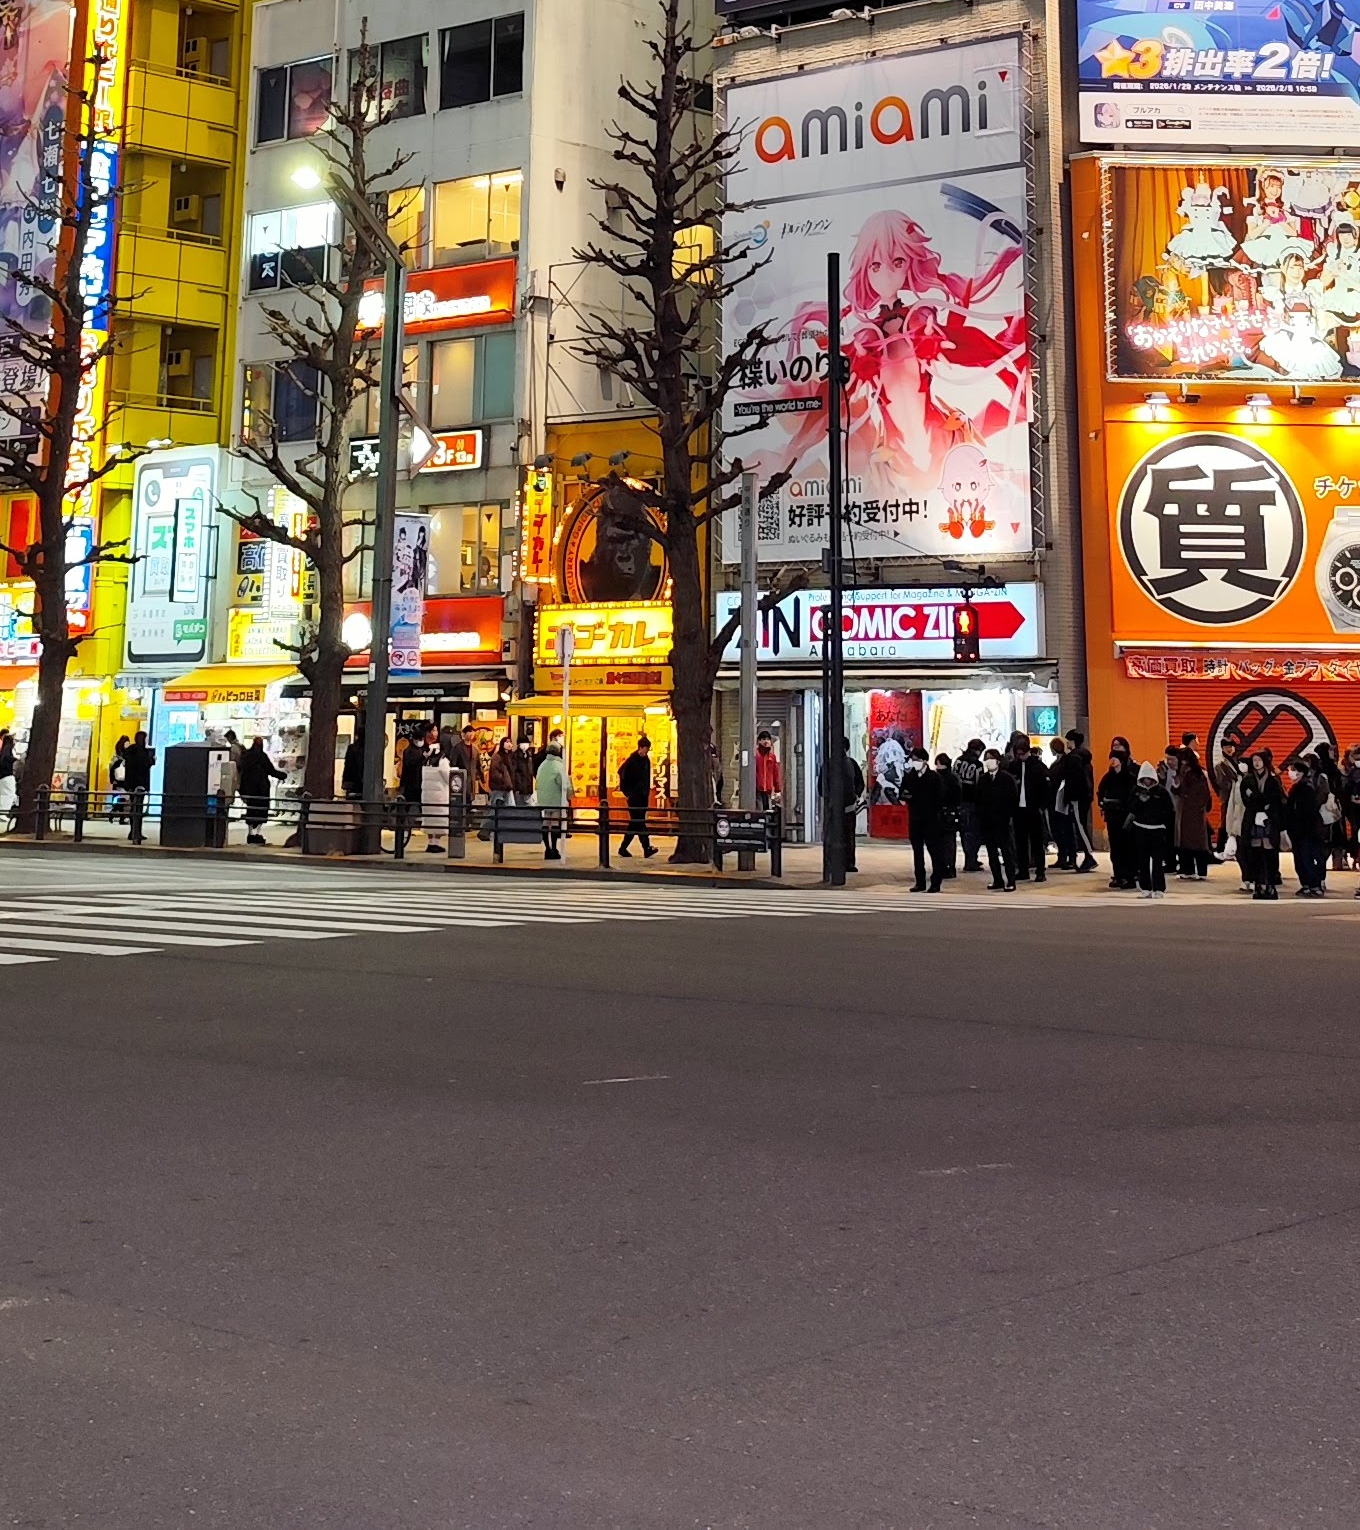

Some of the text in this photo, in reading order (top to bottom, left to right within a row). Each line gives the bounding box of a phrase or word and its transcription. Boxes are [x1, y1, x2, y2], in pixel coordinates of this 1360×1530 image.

[753, 80, 990, 164] amiami
[1132, 105, 1162, 115] ブルアカ
[761, 402, 774, 413] the
[774, 400, 796, 411] world
[796, 400, 805, 410] to
[789, 476, 862, 498] amimi
[184, 507, 196, 549] スマホ
[787, 498, 928, 528] 好評約受付中!
[1140, 462, 1279, 600] 質
